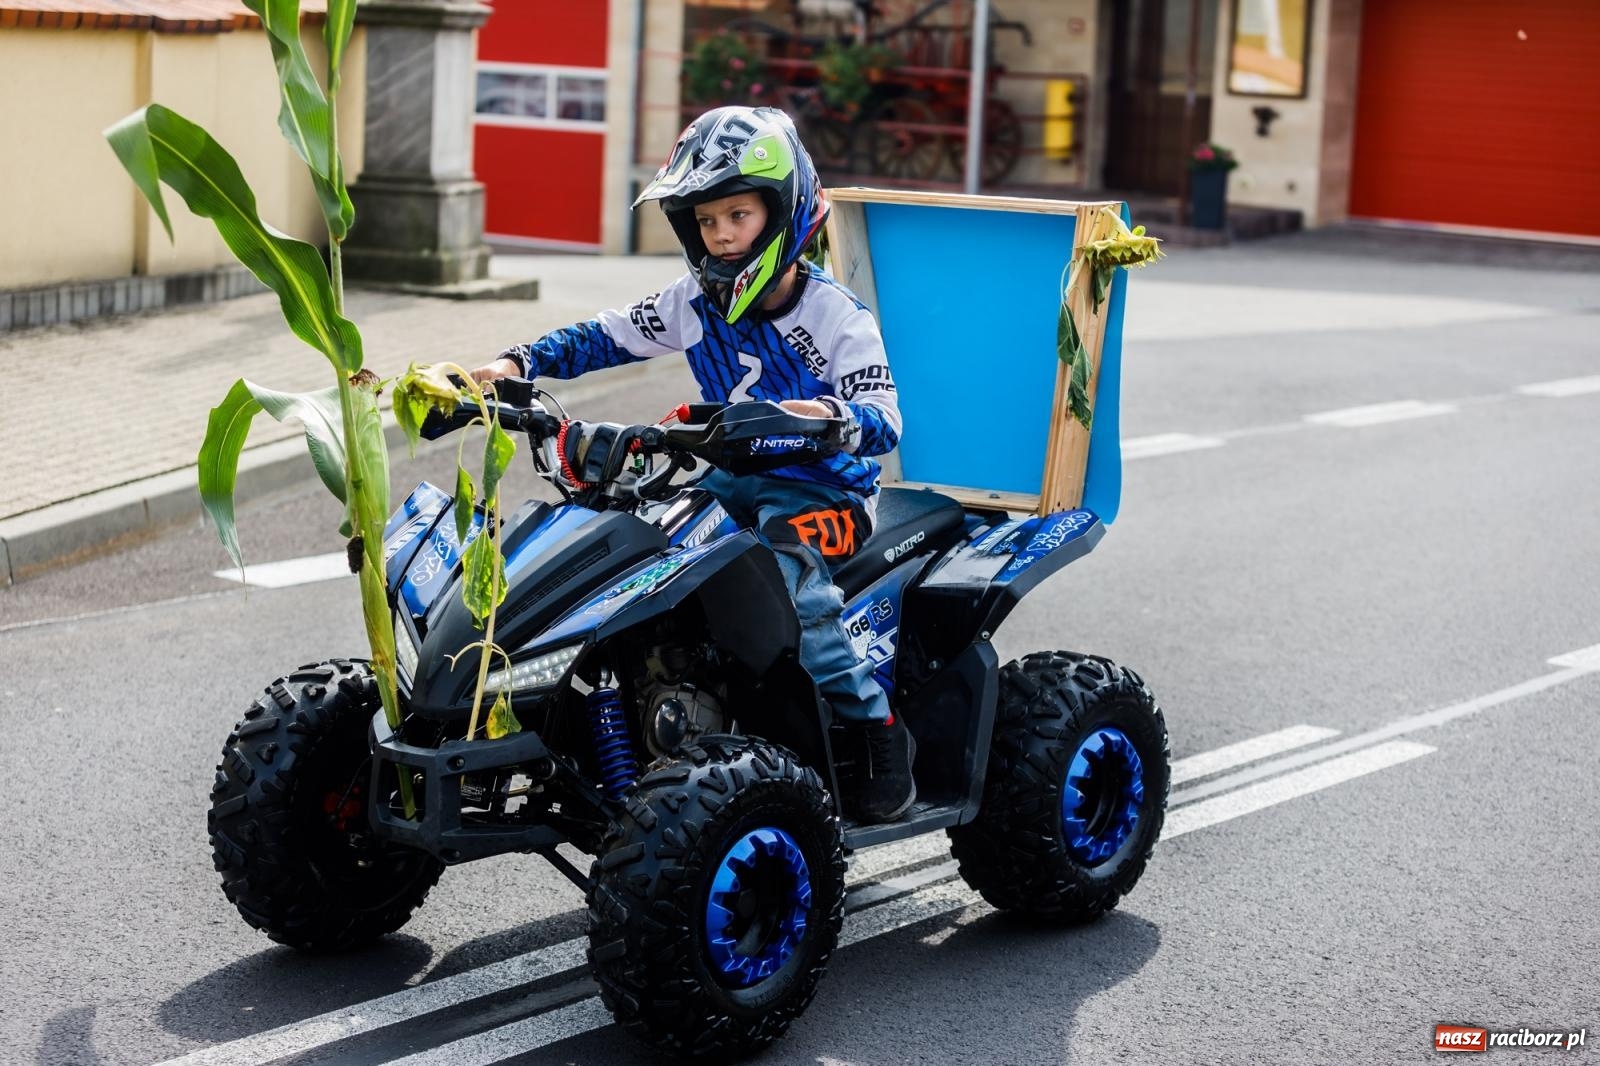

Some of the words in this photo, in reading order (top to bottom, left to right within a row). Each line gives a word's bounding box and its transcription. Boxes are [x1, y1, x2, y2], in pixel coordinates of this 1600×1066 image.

[791, 325, 829, 368] MOTO
[727, 351, 763, 404] 2
[762, 439, 805, 448] NITRO
[786, 508, 856, 556] FOX
[894, 530, 926, 555] NITRO
[869, 597, 893, 625] RS
